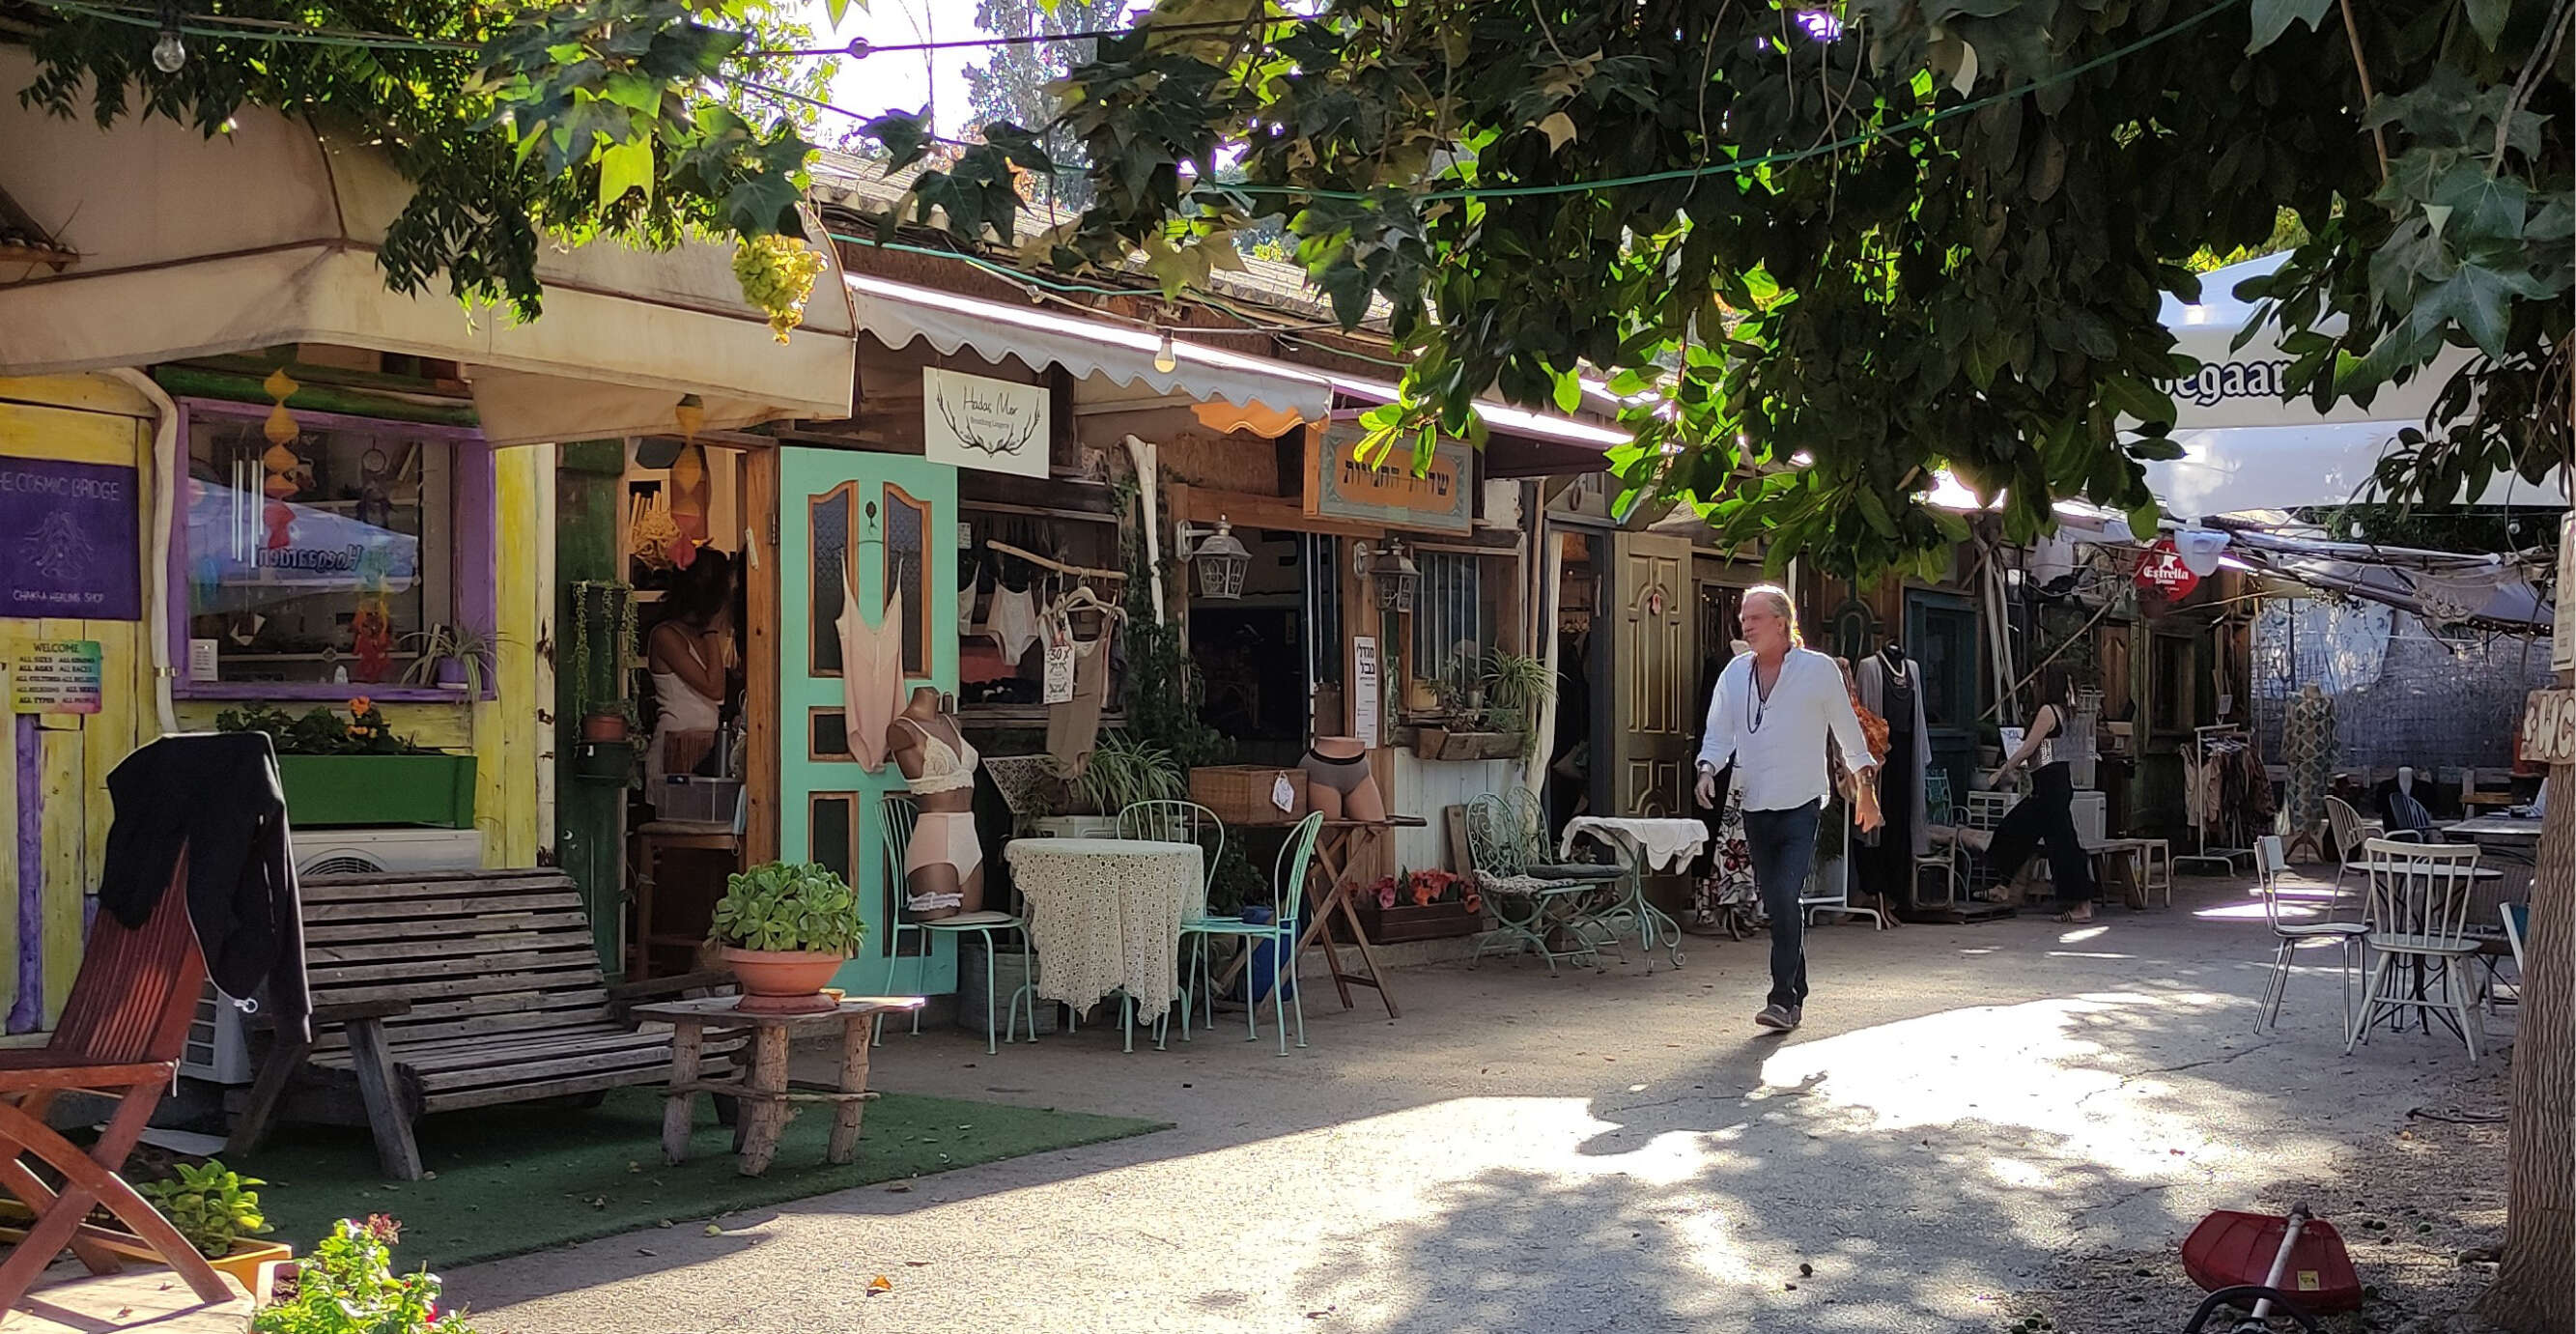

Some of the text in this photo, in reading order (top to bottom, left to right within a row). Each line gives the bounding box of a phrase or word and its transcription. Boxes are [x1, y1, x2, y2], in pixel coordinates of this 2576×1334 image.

[963, 385, 992, 414] Hadas
[15, 472, 69, 496] COSMIC
[71, 478, 121, 501] BRIDGE
[2142, 565, 2190, 581] Estrella
[33, 642, 79, 653] WELCOME
